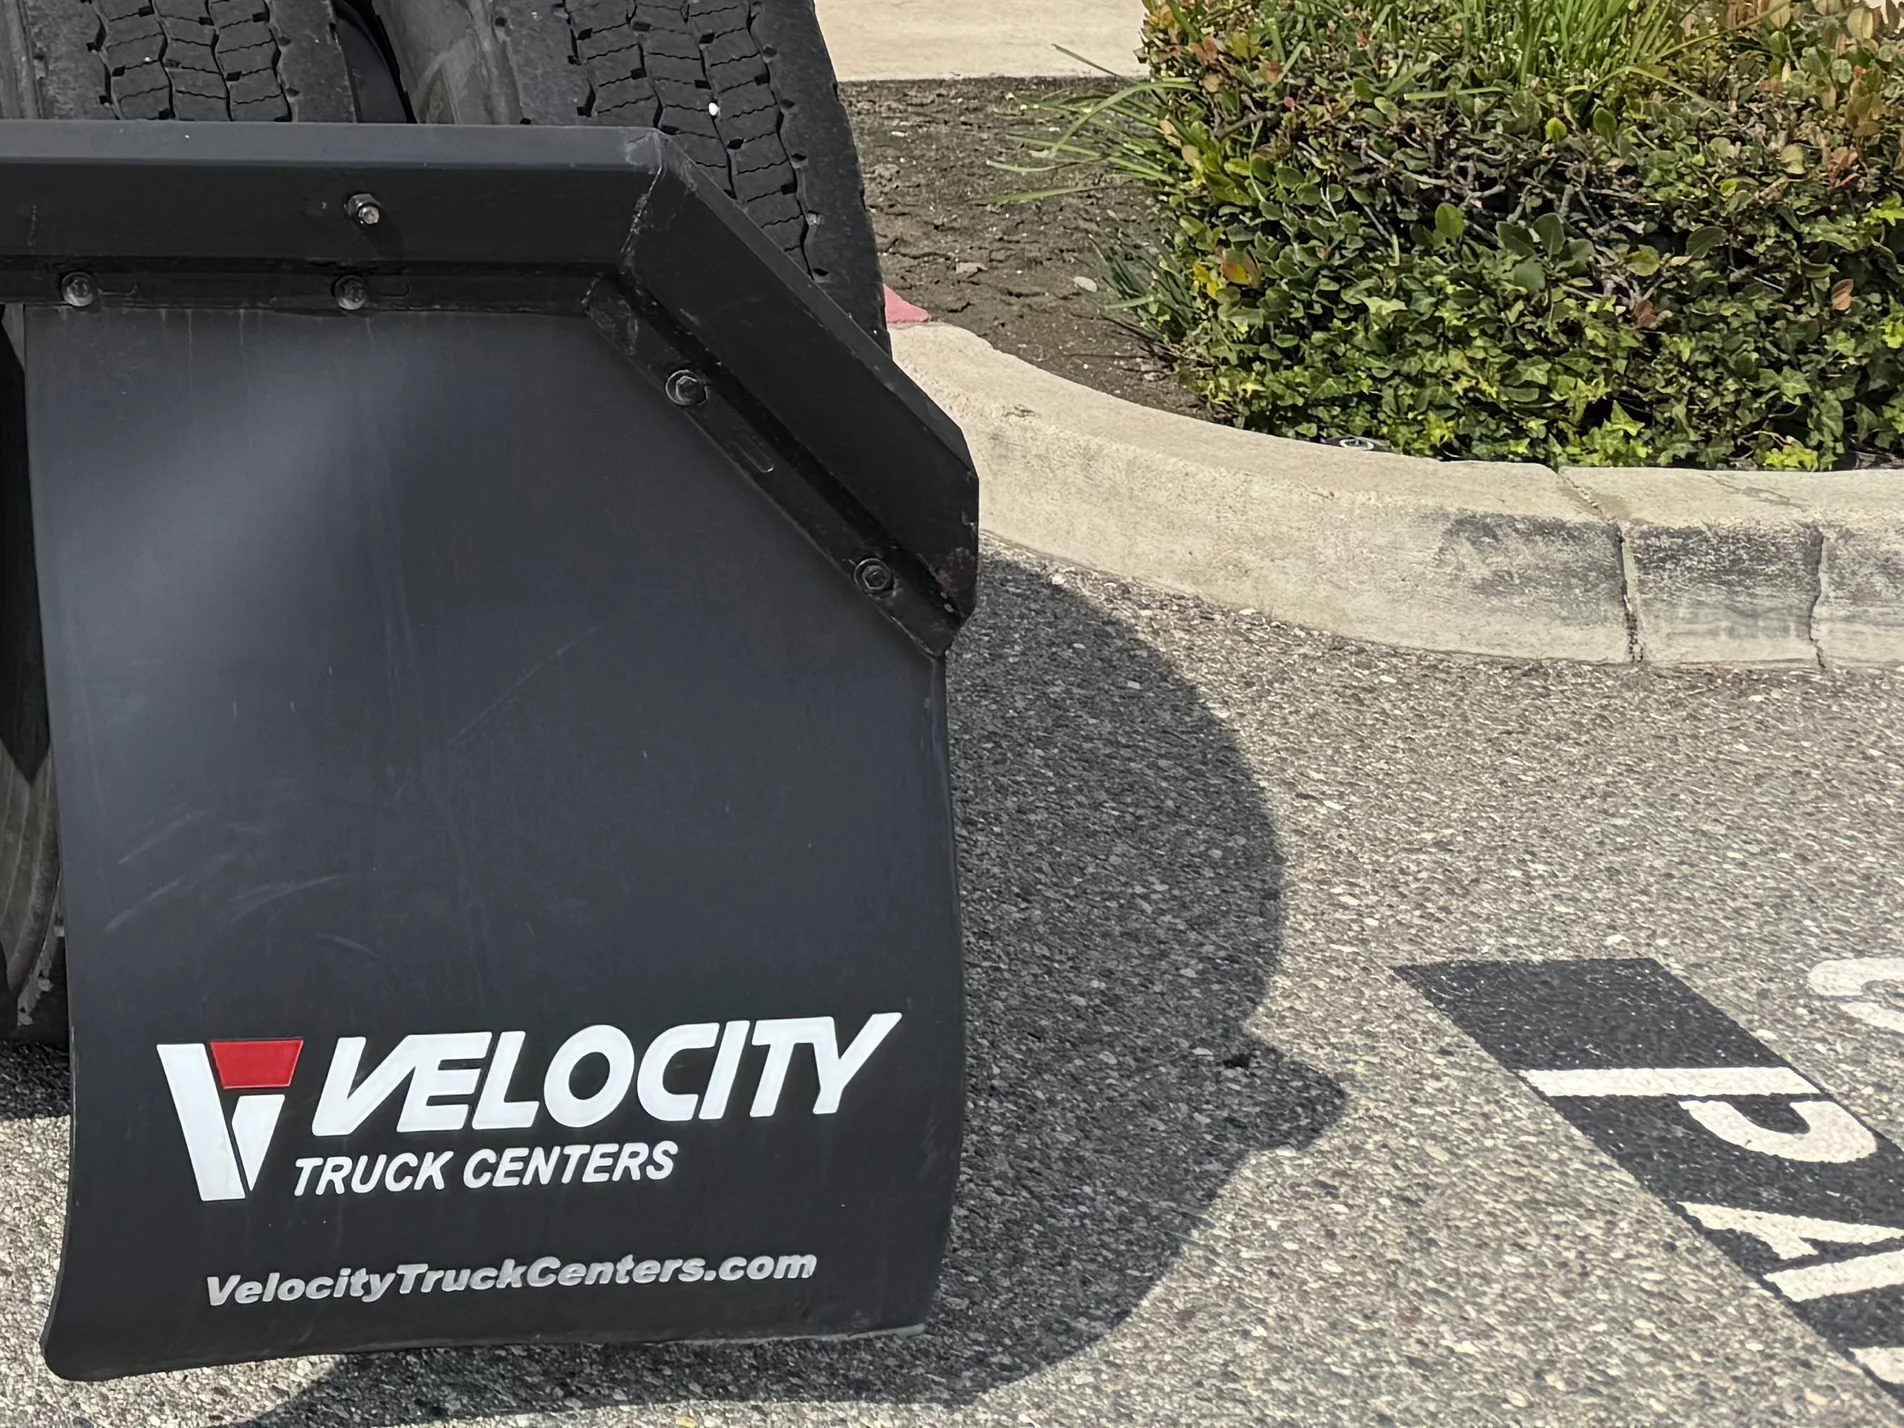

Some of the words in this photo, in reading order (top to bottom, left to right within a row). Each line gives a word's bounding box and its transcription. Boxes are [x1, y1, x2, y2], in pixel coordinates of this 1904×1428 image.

[311, 1011, 904, 1138] VELOCITY
[294, 1149, 453, 1197] TRUCK
[463, 1140, 679, 1189] CENTERS
[206, 1251, 818, 1307] VelocityTruckCenters.com
